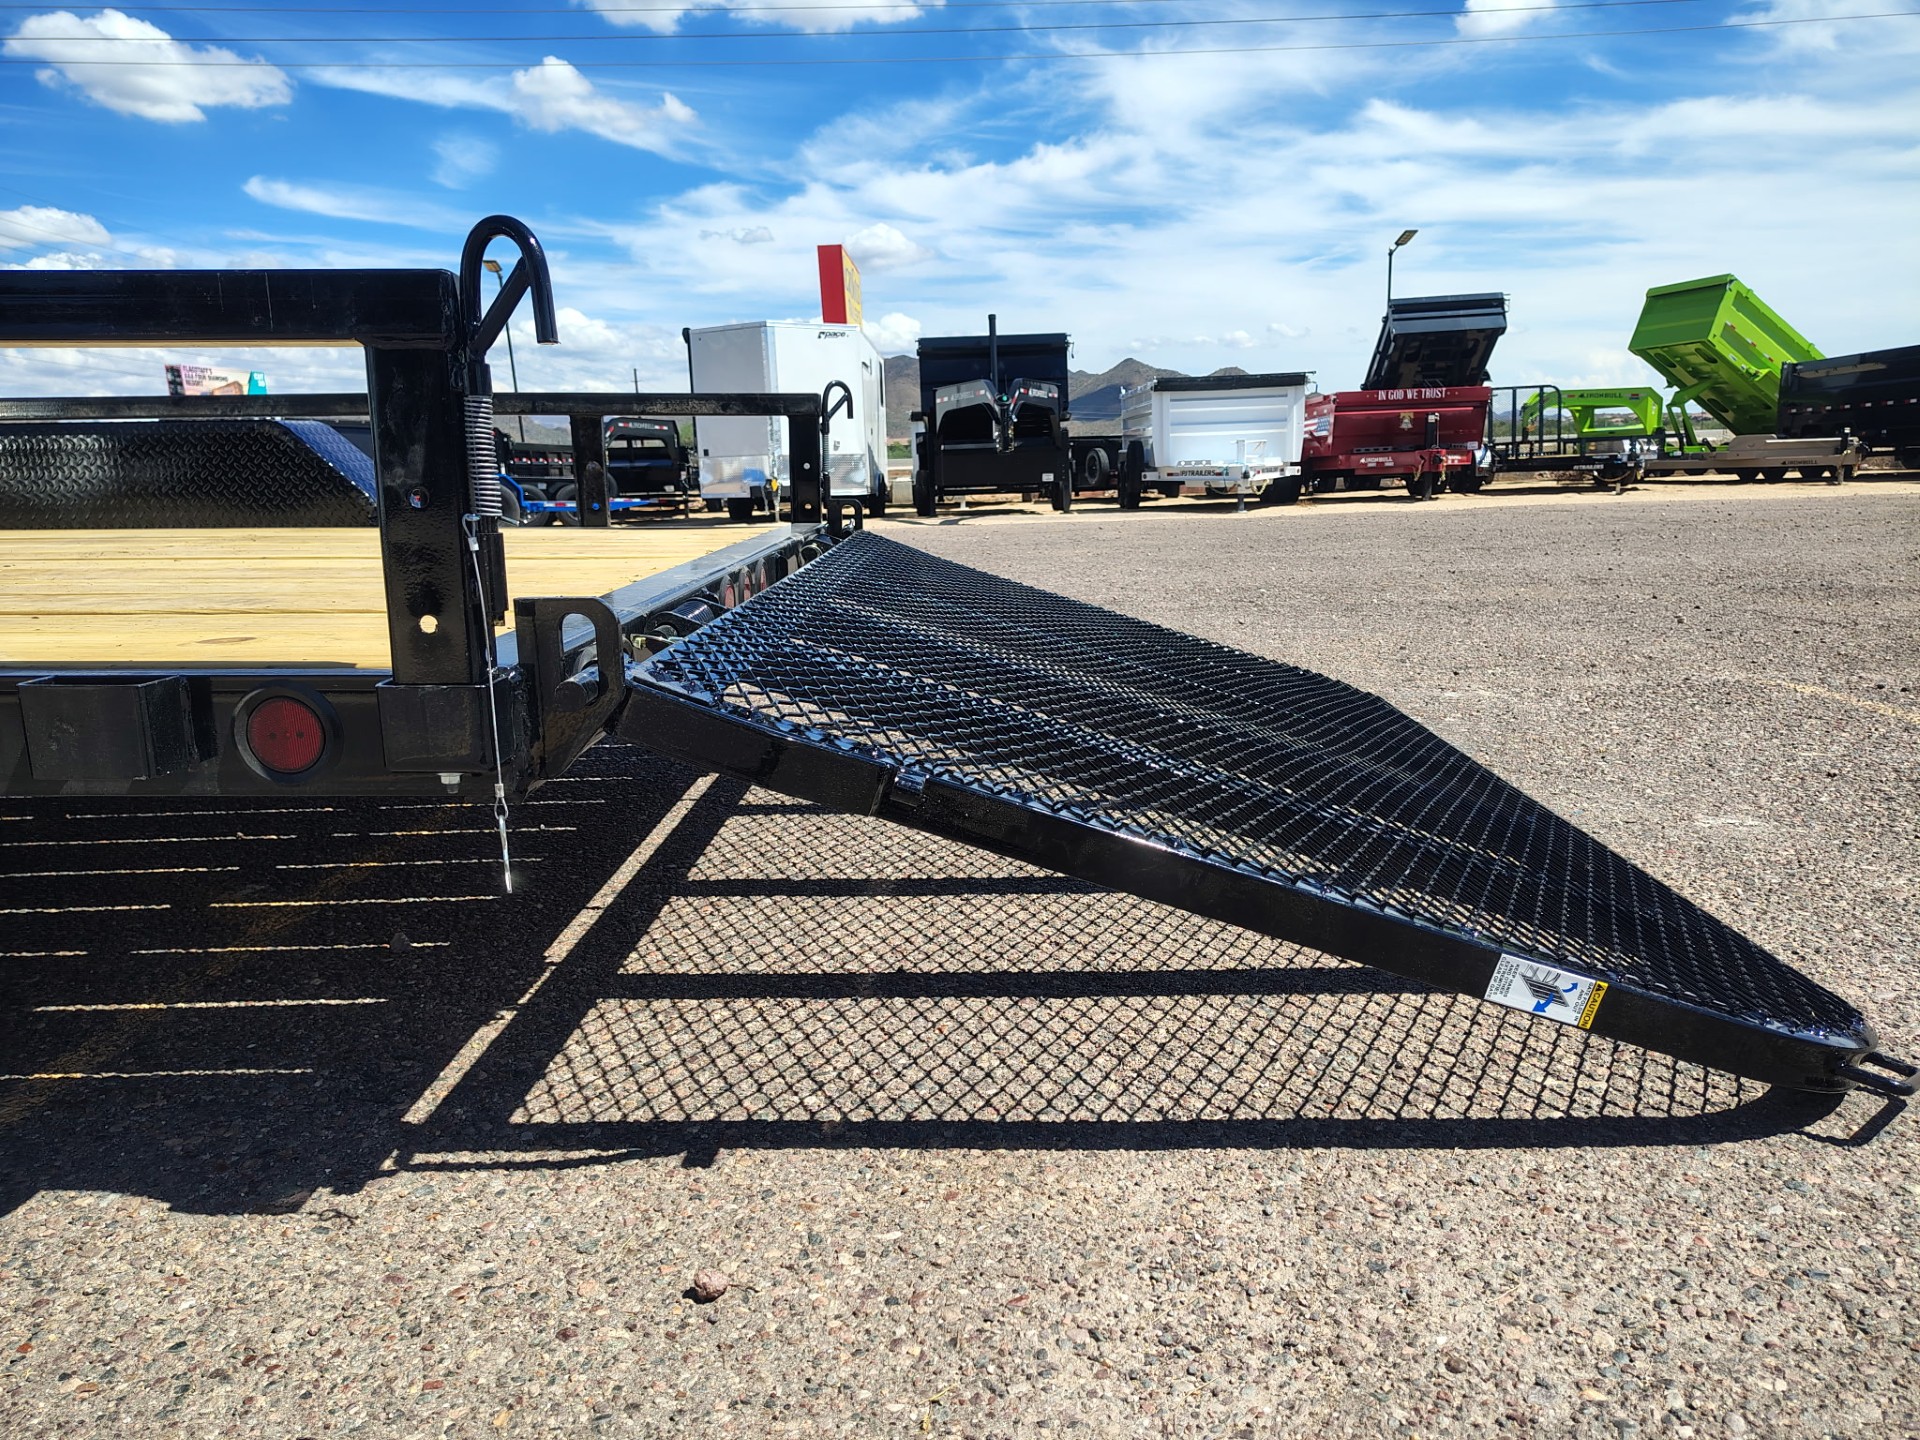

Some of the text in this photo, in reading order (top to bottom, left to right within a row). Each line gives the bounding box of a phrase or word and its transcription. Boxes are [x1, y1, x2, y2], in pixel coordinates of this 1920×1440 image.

[1378, 387, 1447, 401] IN GOD WE TRUST
[1495, 956, 1506, 974] CLEAR
[1493, 961, 1510, 995] EXTREMITIES
[1499, 964, 1514, 995] AND OTHER
[1503, 964, 1520, 998] KEEP HANDS
[1584, 982, 1594, 996] GATE
[1487, 984, 1495, 998] GATE
[1581, 991, 1601, 1028] CAUTION
